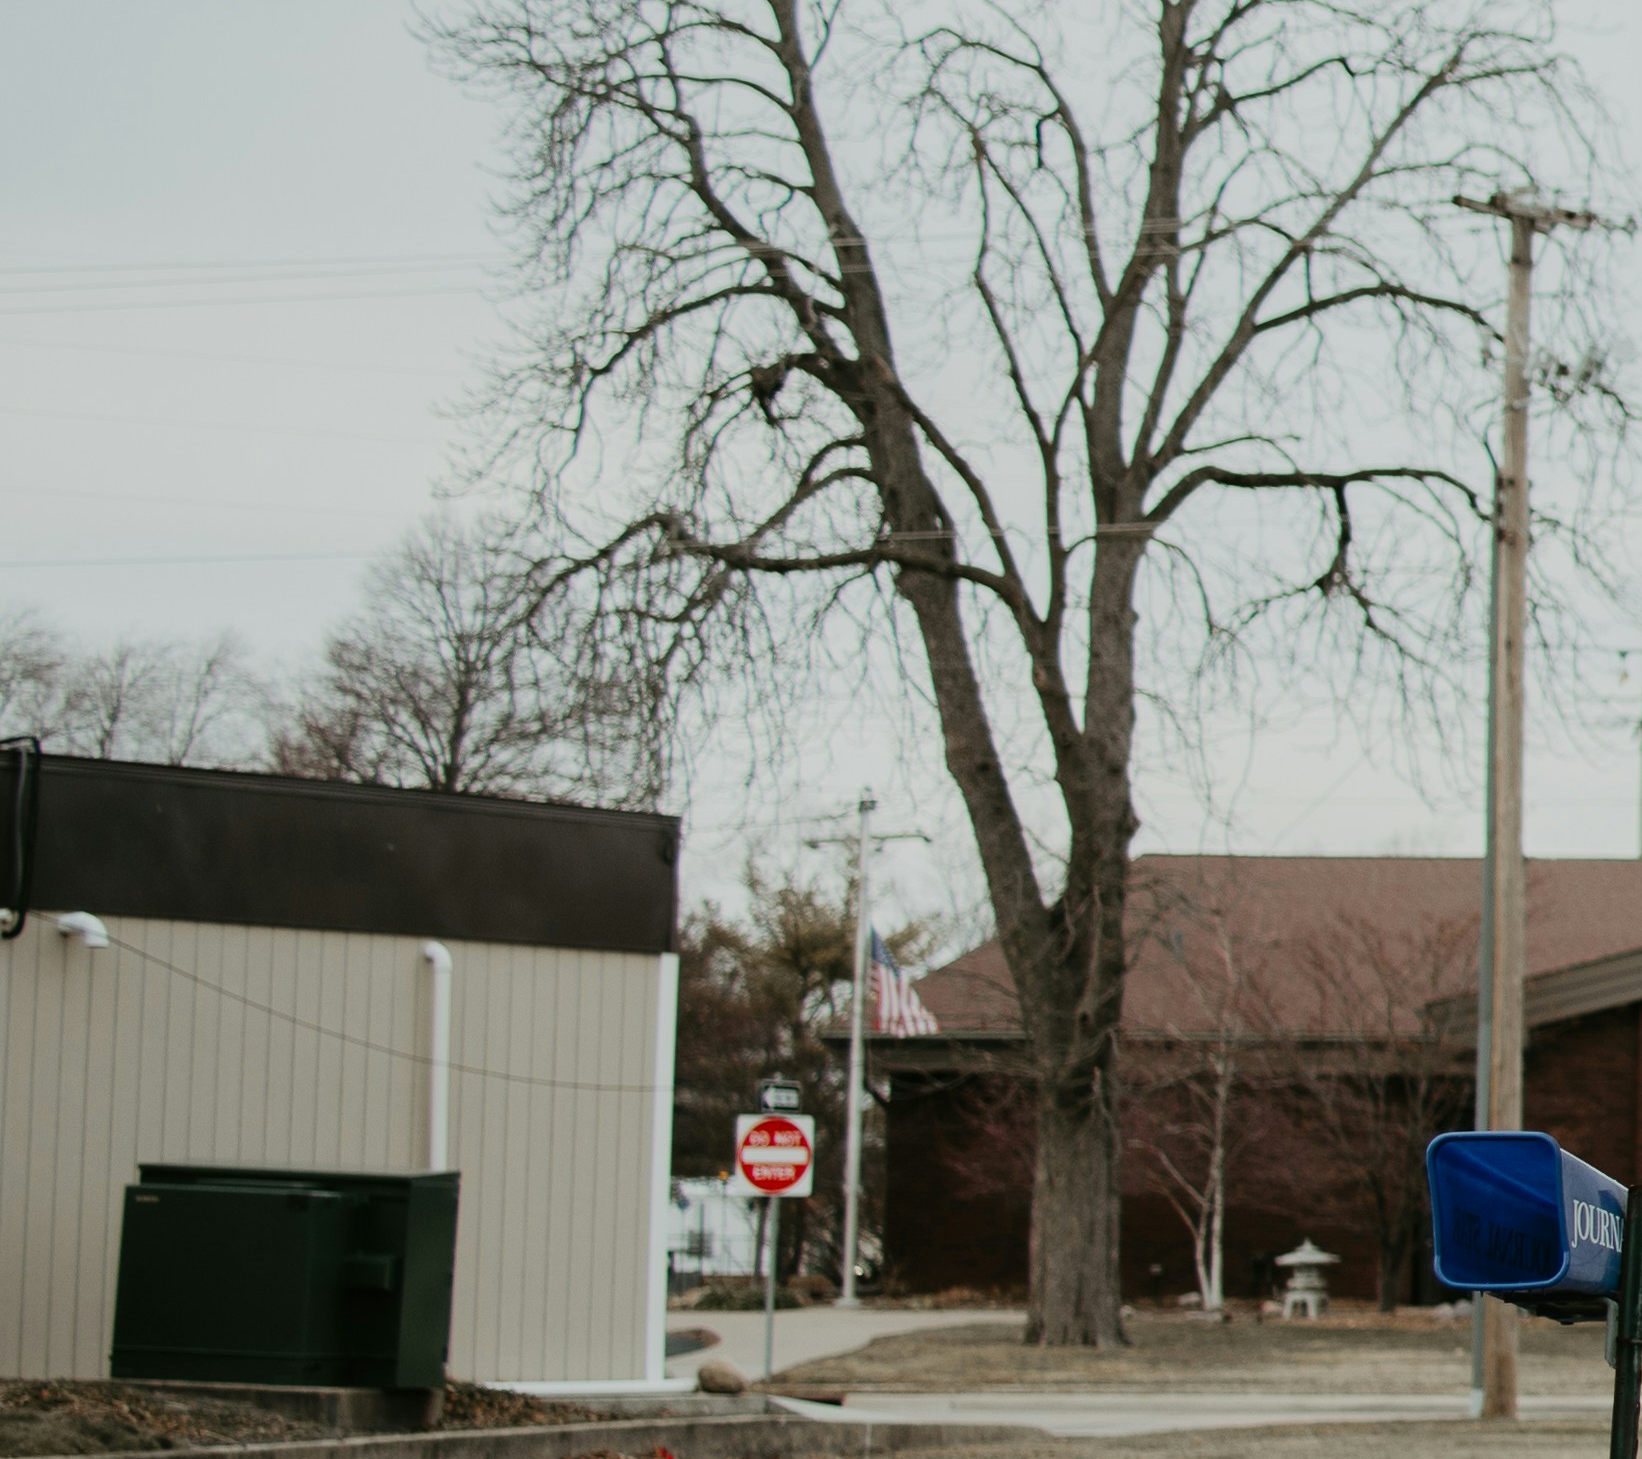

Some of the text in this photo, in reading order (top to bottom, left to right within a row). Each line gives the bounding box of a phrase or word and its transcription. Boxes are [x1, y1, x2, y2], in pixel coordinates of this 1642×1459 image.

[749, 1129, 802, 1147] DO NOT
[752, 1164, 796, 1181] ENTER
[1571, 1199, 1625, 1253] JOURN
